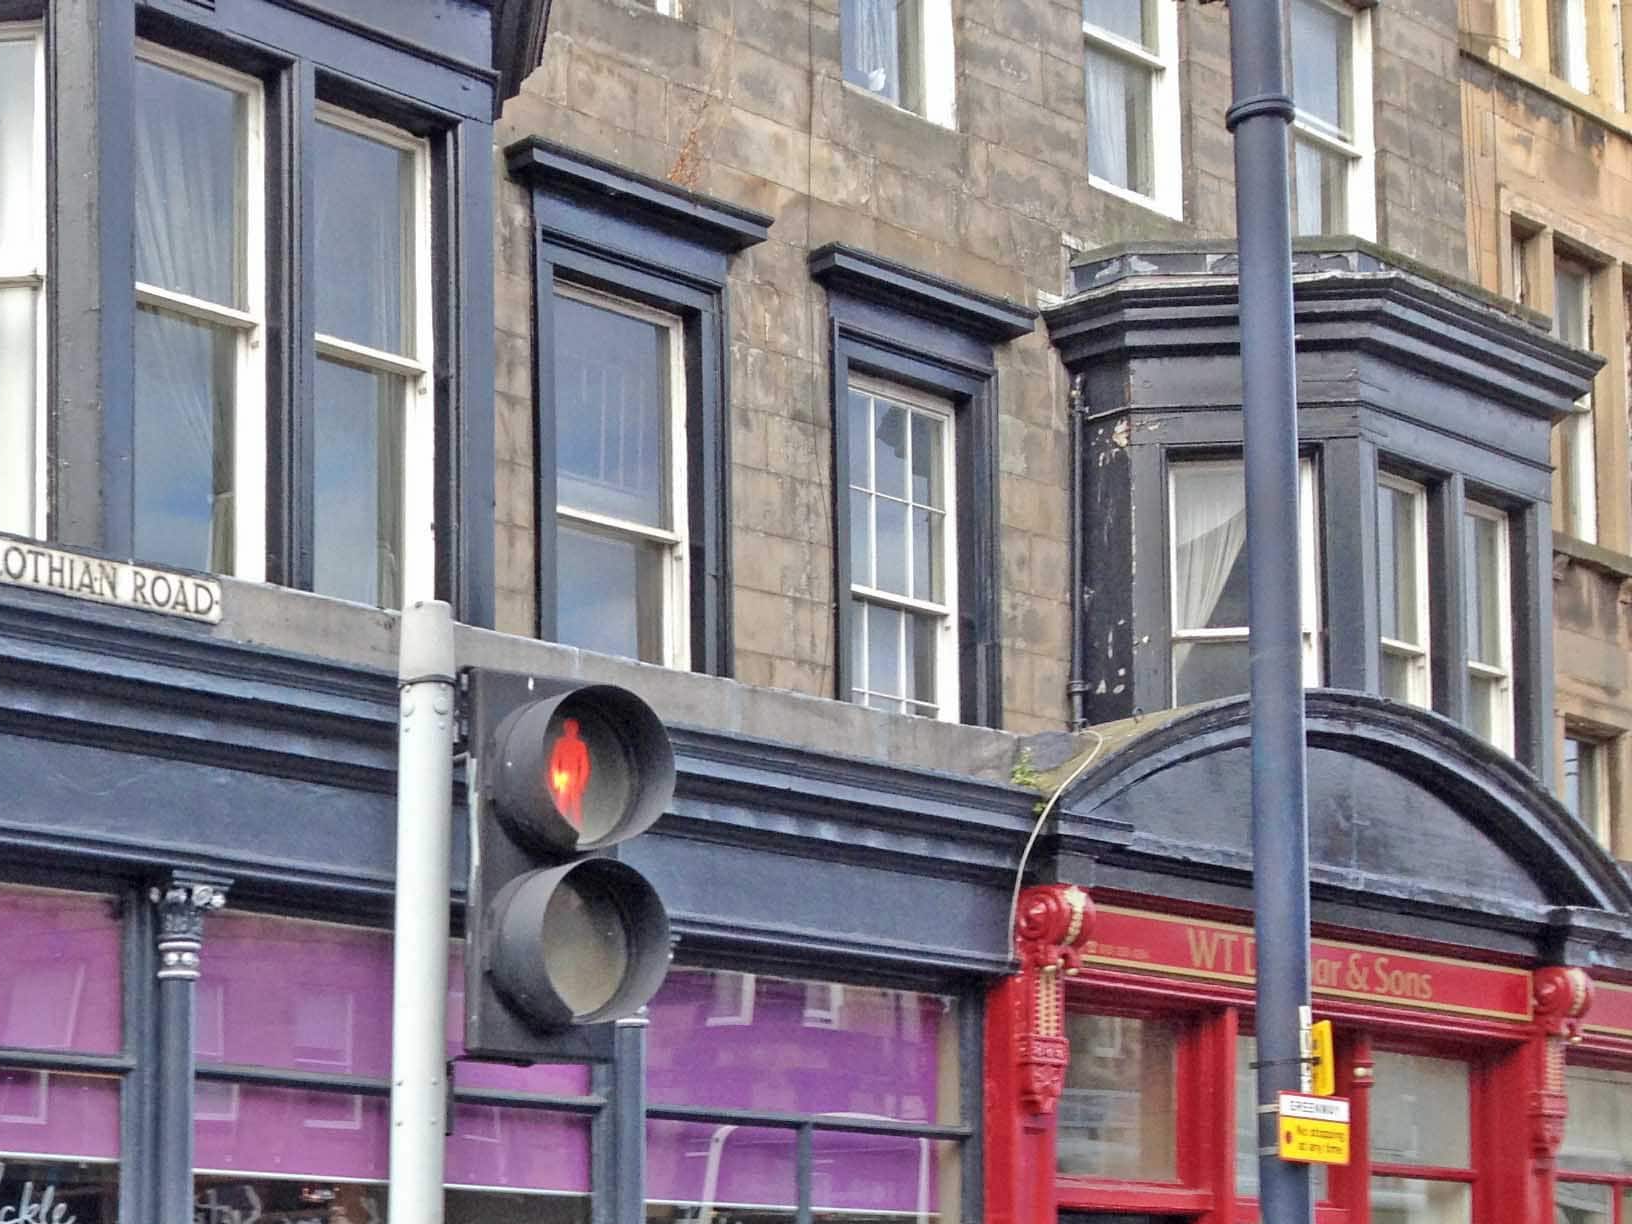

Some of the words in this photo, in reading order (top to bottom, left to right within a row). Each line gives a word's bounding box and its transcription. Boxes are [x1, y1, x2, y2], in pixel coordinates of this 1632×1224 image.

[133, 570, 214, 616] ROAD
[1187, 927, 1239, 972] WT
[1346, 952, 1369, 991] &
[1374, 956, 1433, 999] Sons
